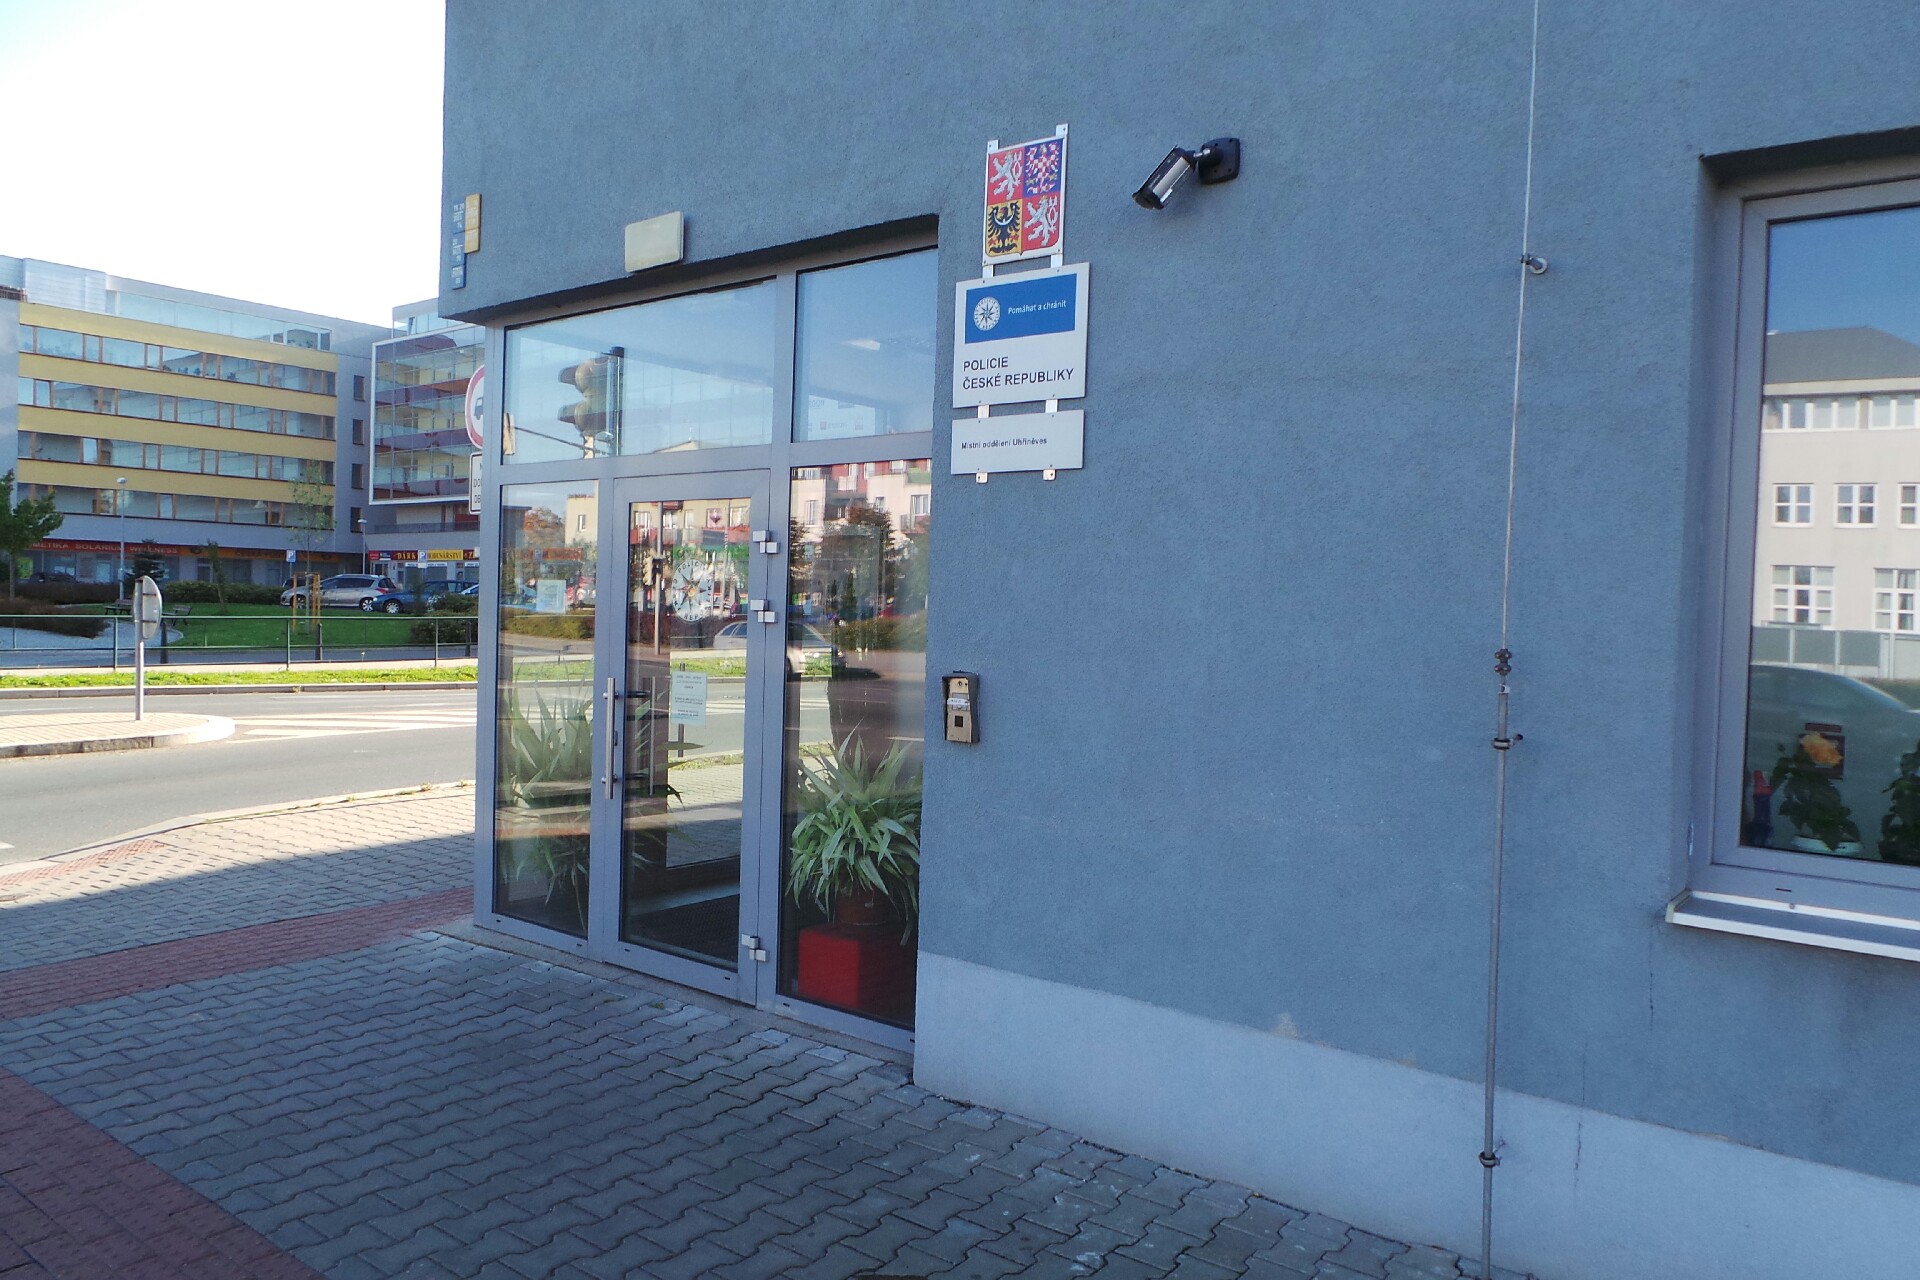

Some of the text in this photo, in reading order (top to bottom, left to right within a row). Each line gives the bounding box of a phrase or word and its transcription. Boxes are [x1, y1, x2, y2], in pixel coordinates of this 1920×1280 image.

[1008, 304, 1036, 314] Pomáhat
[1043, 300, 1066, 310] chránit
[963, 356, 1009, 372] POLICIE
[963, 368, 1074, 390] ČESKÉ REPUBLIKY
[961, 437, 1048, 449] Místní oddělení Uhříněves
[397, 551, 417, 559] DÁRK
